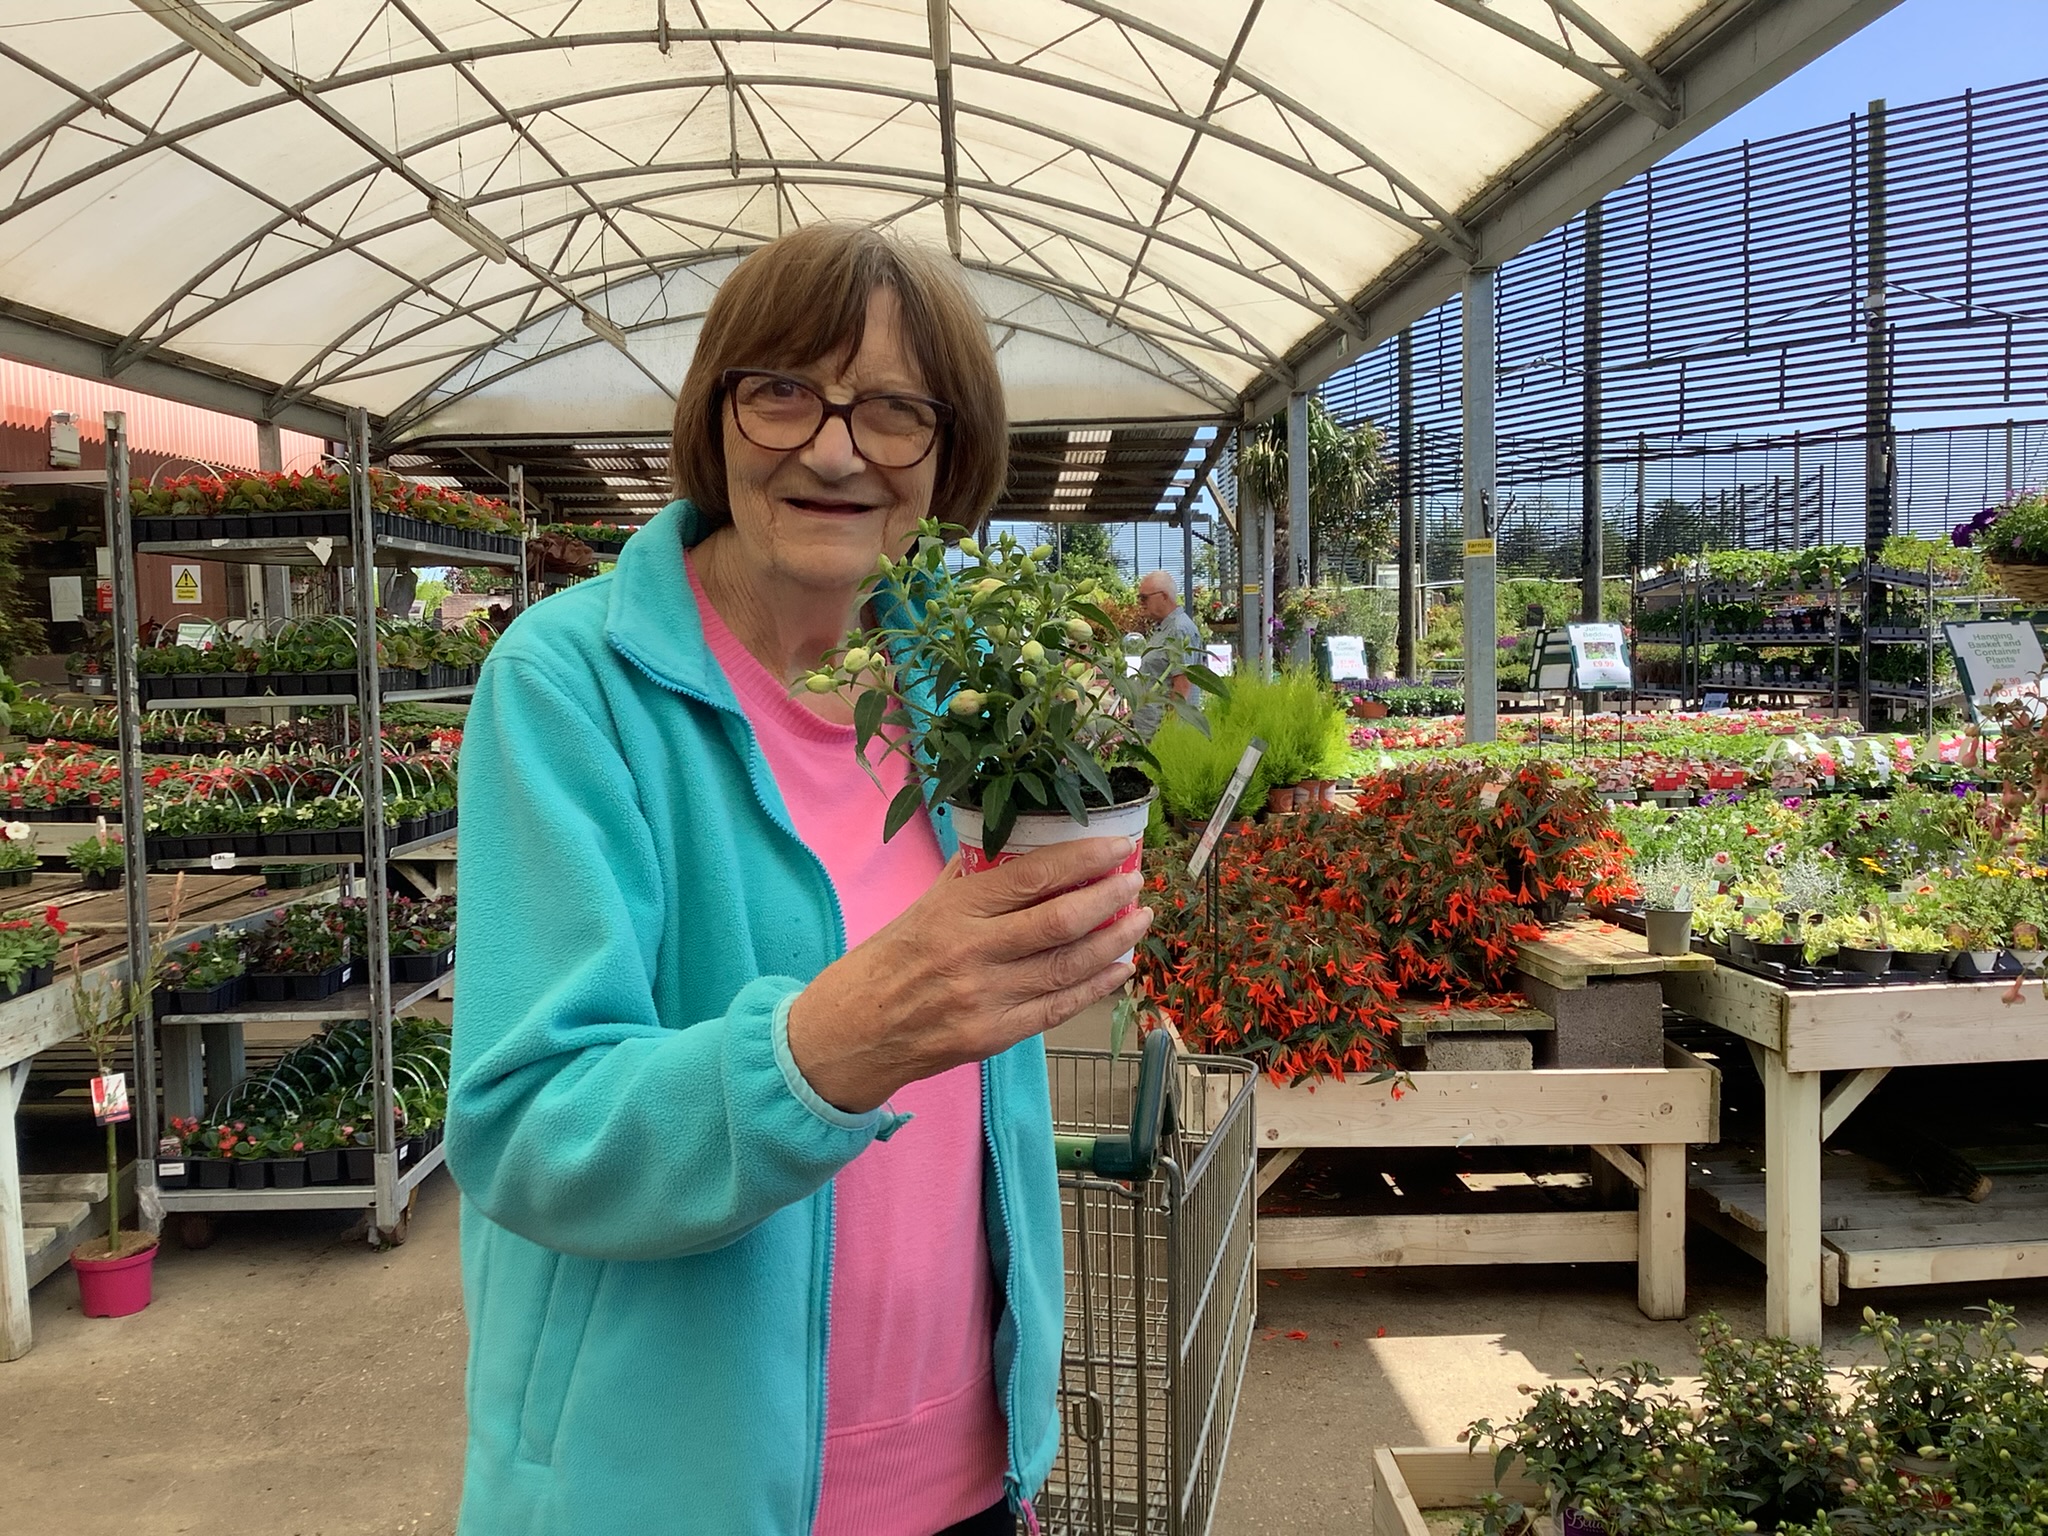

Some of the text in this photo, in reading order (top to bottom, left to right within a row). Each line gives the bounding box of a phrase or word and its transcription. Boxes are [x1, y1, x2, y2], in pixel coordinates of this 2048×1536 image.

[1973, 633, 2014, 641] Hanging
[1968, 639, 2021, 649] Basket and
[1974, 648, 2021, 656] Container
[1985, 656, 2016, 664] Plants
